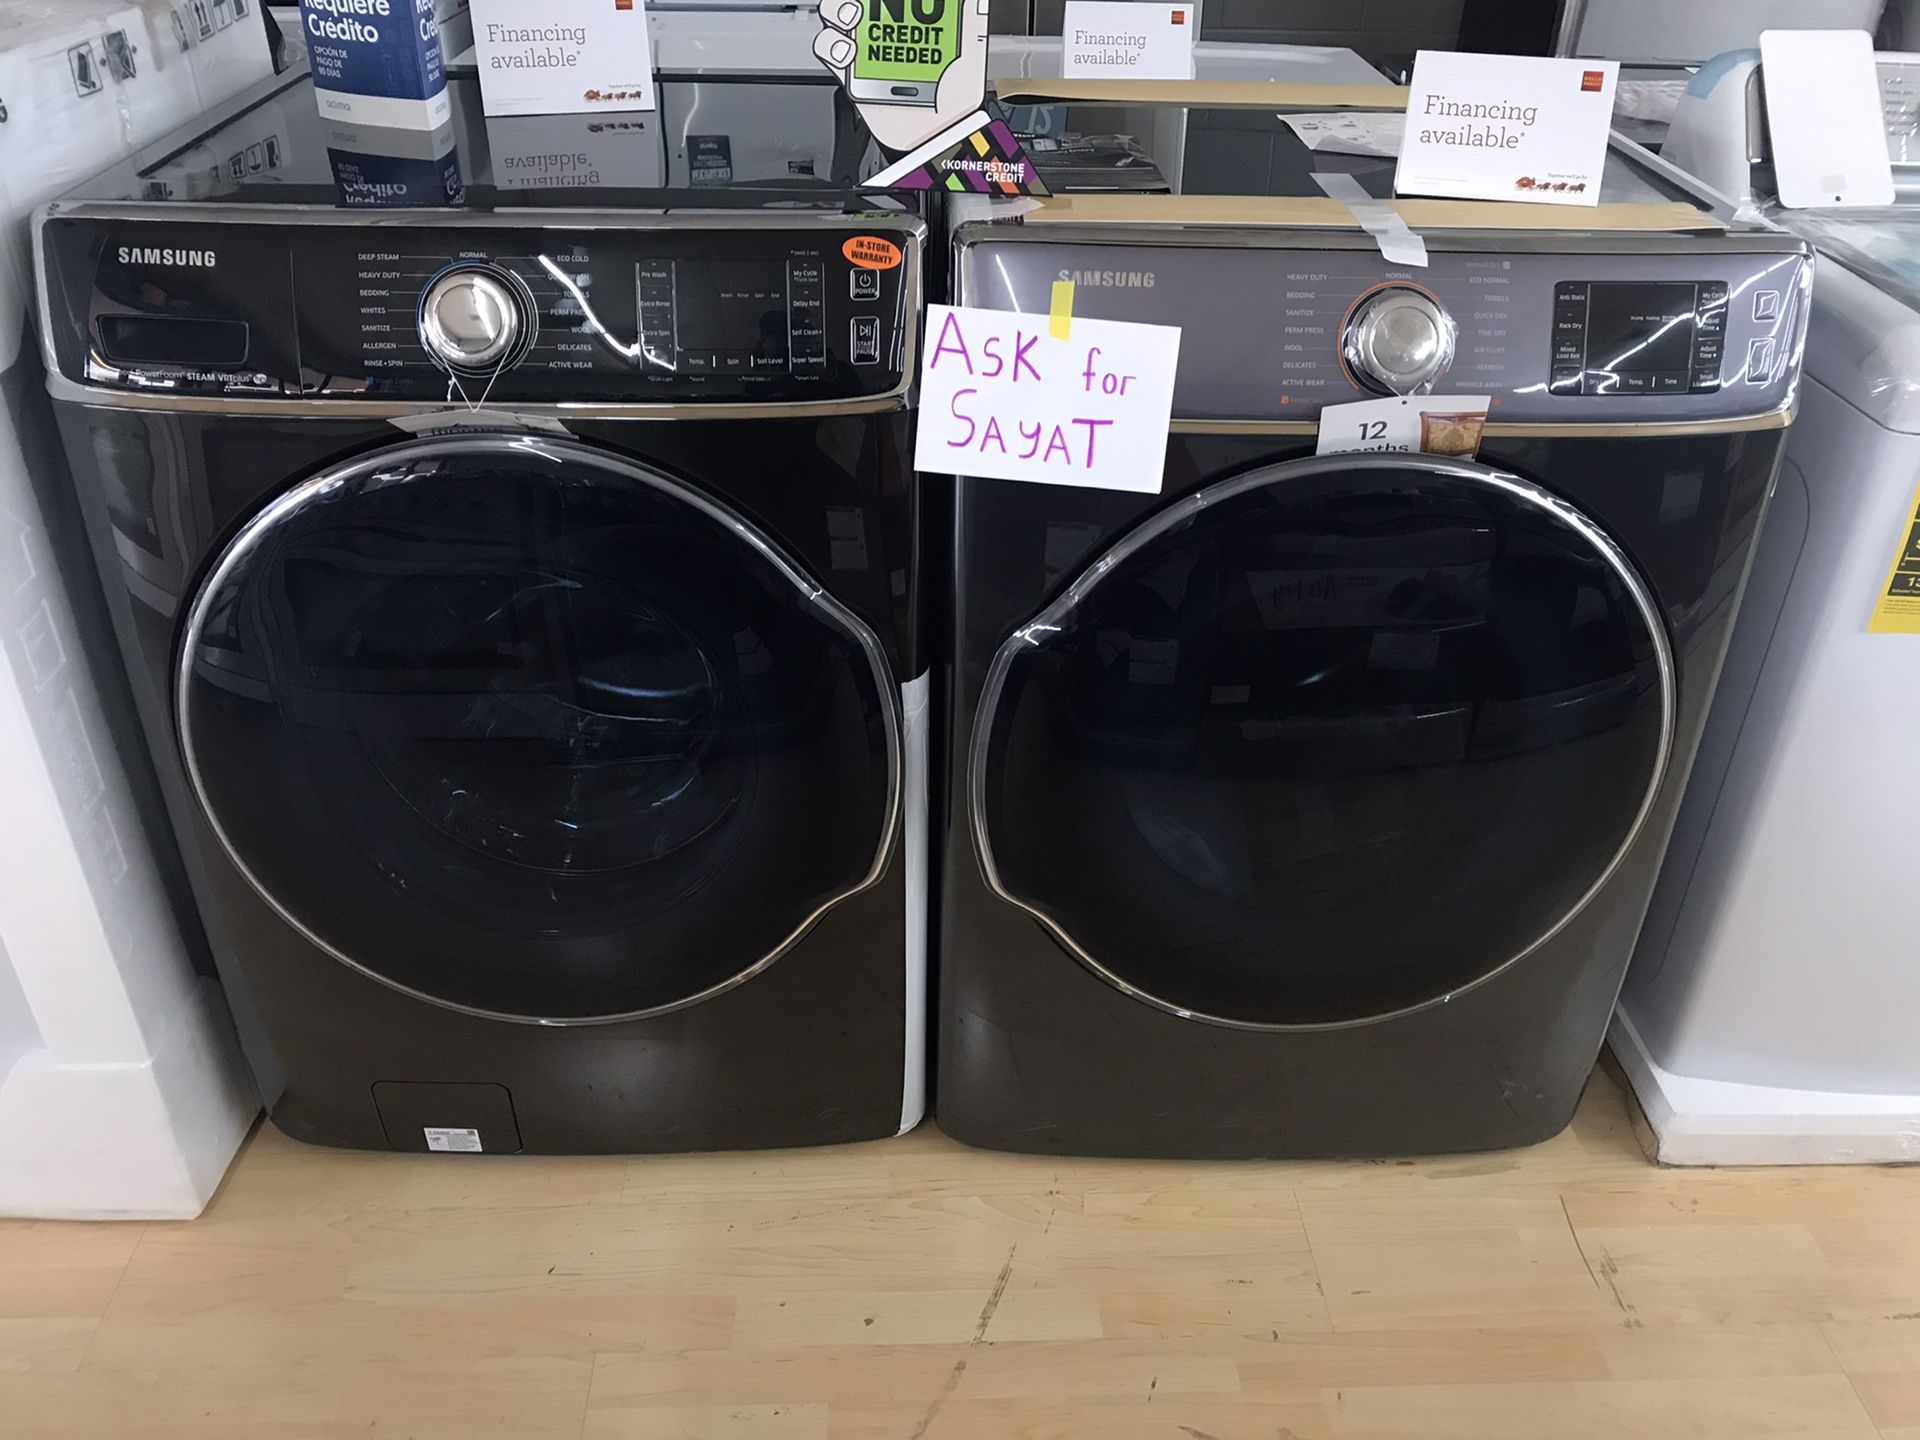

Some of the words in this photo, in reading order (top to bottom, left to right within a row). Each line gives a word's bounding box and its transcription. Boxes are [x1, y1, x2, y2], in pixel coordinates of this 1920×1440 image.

[308, 13, 379, 43] Crédito
[486, 23, 586, 45] Financing
[868, 23, 944, 45] CREDIT
[1074, 30, 1147, 49] Financing
[867, 44, 942, 65] NEEDED
[1424, 94, 1538, 127] Financing
[985, 171, 1024, 183] CREDIT
[856, 239, 890, 254] IN-STORE
[118, 246, 216, 267] SAMSUNG
[851, 250, 893, 265] WARRANTY
[1058, 269, 1155, 288] SAMSUNG
[1286, 273, 1309, 281] HEAVY
[1310, 273, 1329, 281] DUTY
[1385, 272, 1413, 280] NORMAL
[360, 289, 389, 297] BEDDING
[1286, 291, 1316, 299] BEDDING
[1285, 308, 1314, 316] SANITIZE
[361, 324, 391, 332] SANITIZE
[1285, 326, 1303, 334] PERM
[362, 342, 397, 350] ALLERGEN
[549, 361, 571, 369] ACTIVE
[1082, 346, 1137, 396] for
[1282, 361, 1317, 369] DELICATES
[186, 372, 215, 381] STEAM
[1358, 421, 1388, 441] 12
